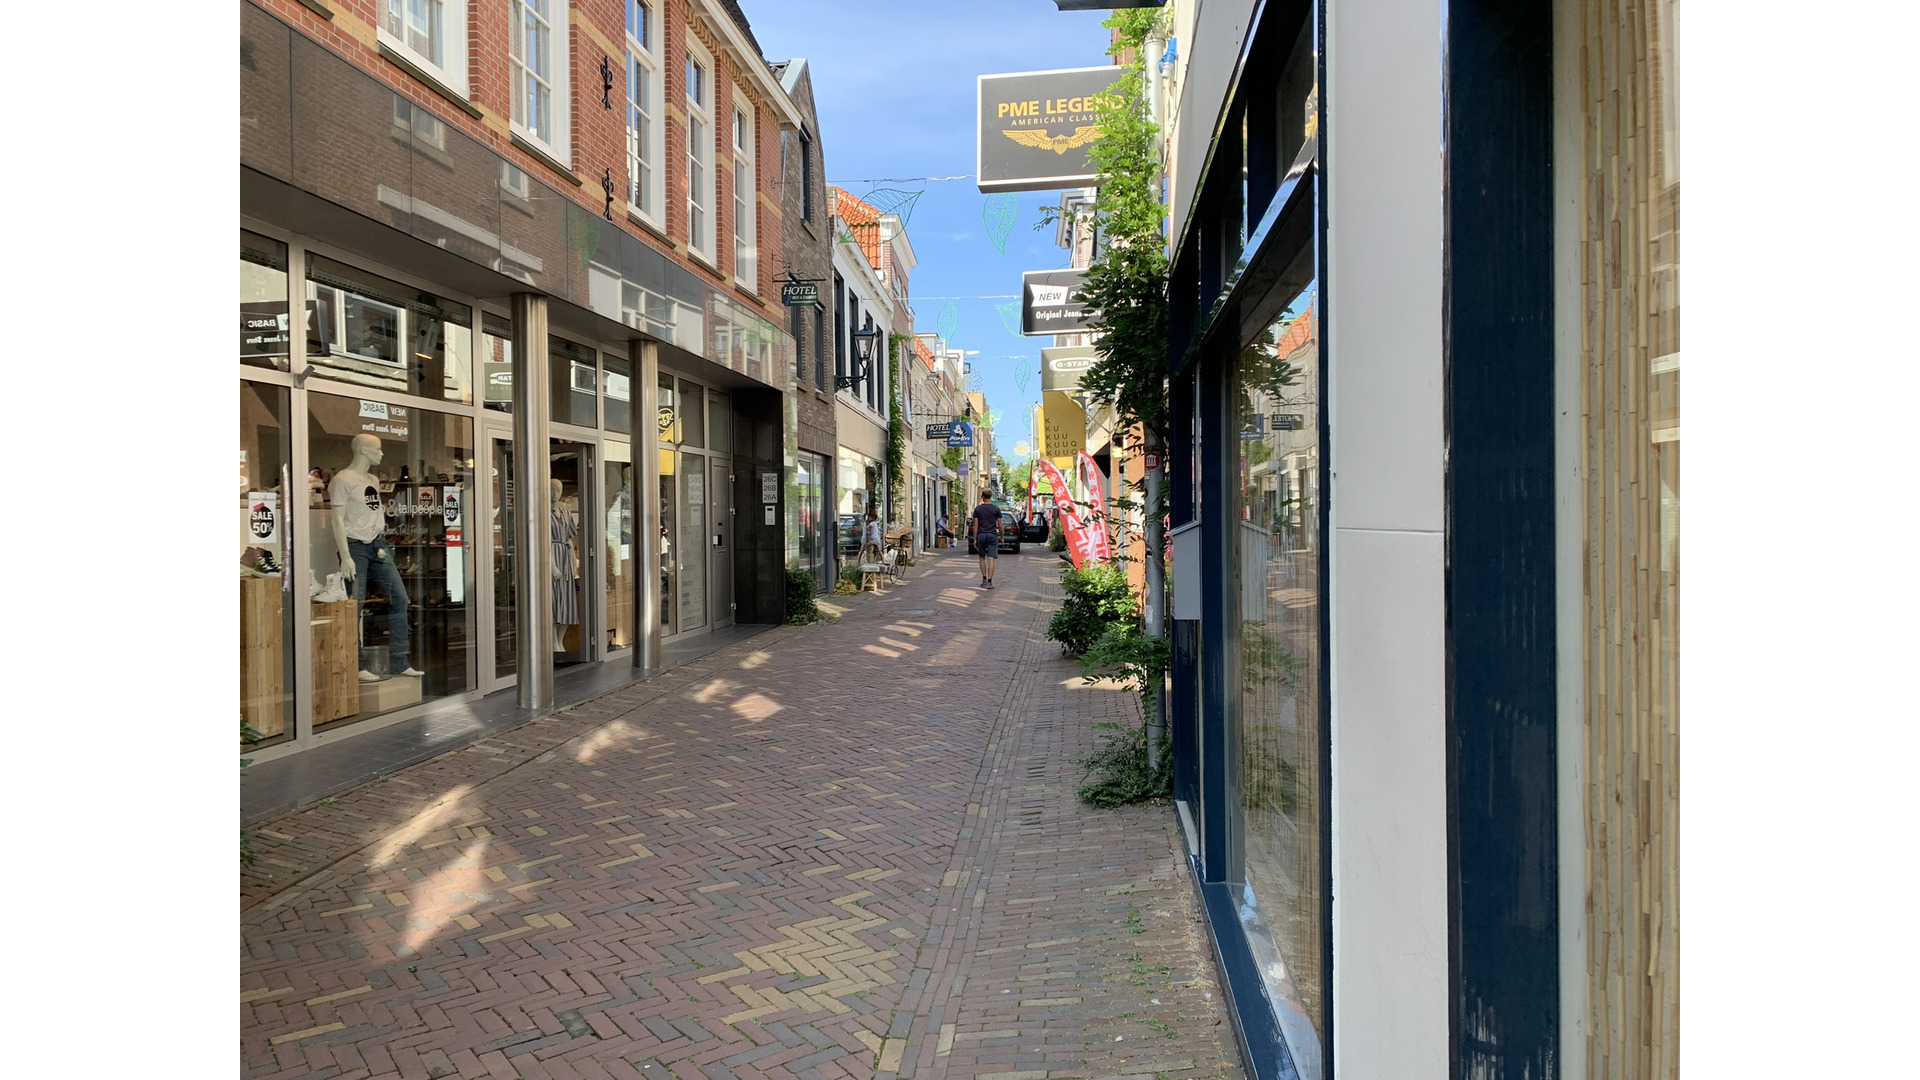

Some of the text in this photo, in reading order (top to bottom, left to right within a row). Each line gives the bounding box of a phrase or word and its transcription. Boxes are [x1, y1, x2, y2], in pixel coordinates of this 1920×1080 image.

[998, 100, 1039, 118] PME
[1011, 117, 1064, 126] AMERICAN
[783, 286, 817, 295] HOTEL
[1039, 292, 1062, 301] NEW
[1036, 309, 1062, 321] Original
[1063, 309, 1083, 318] Jeans
[1047, 448, 1084, 457] KUUQ
[763, 475, 777, 483] 26C
[380, 483, 392, 491] 43
[763, 493, 777, 501] 26A
[445, 500, 458, 508] SALE
[251, 511, 273, 520] SALE
[252, 522, 273, 534] 50%
